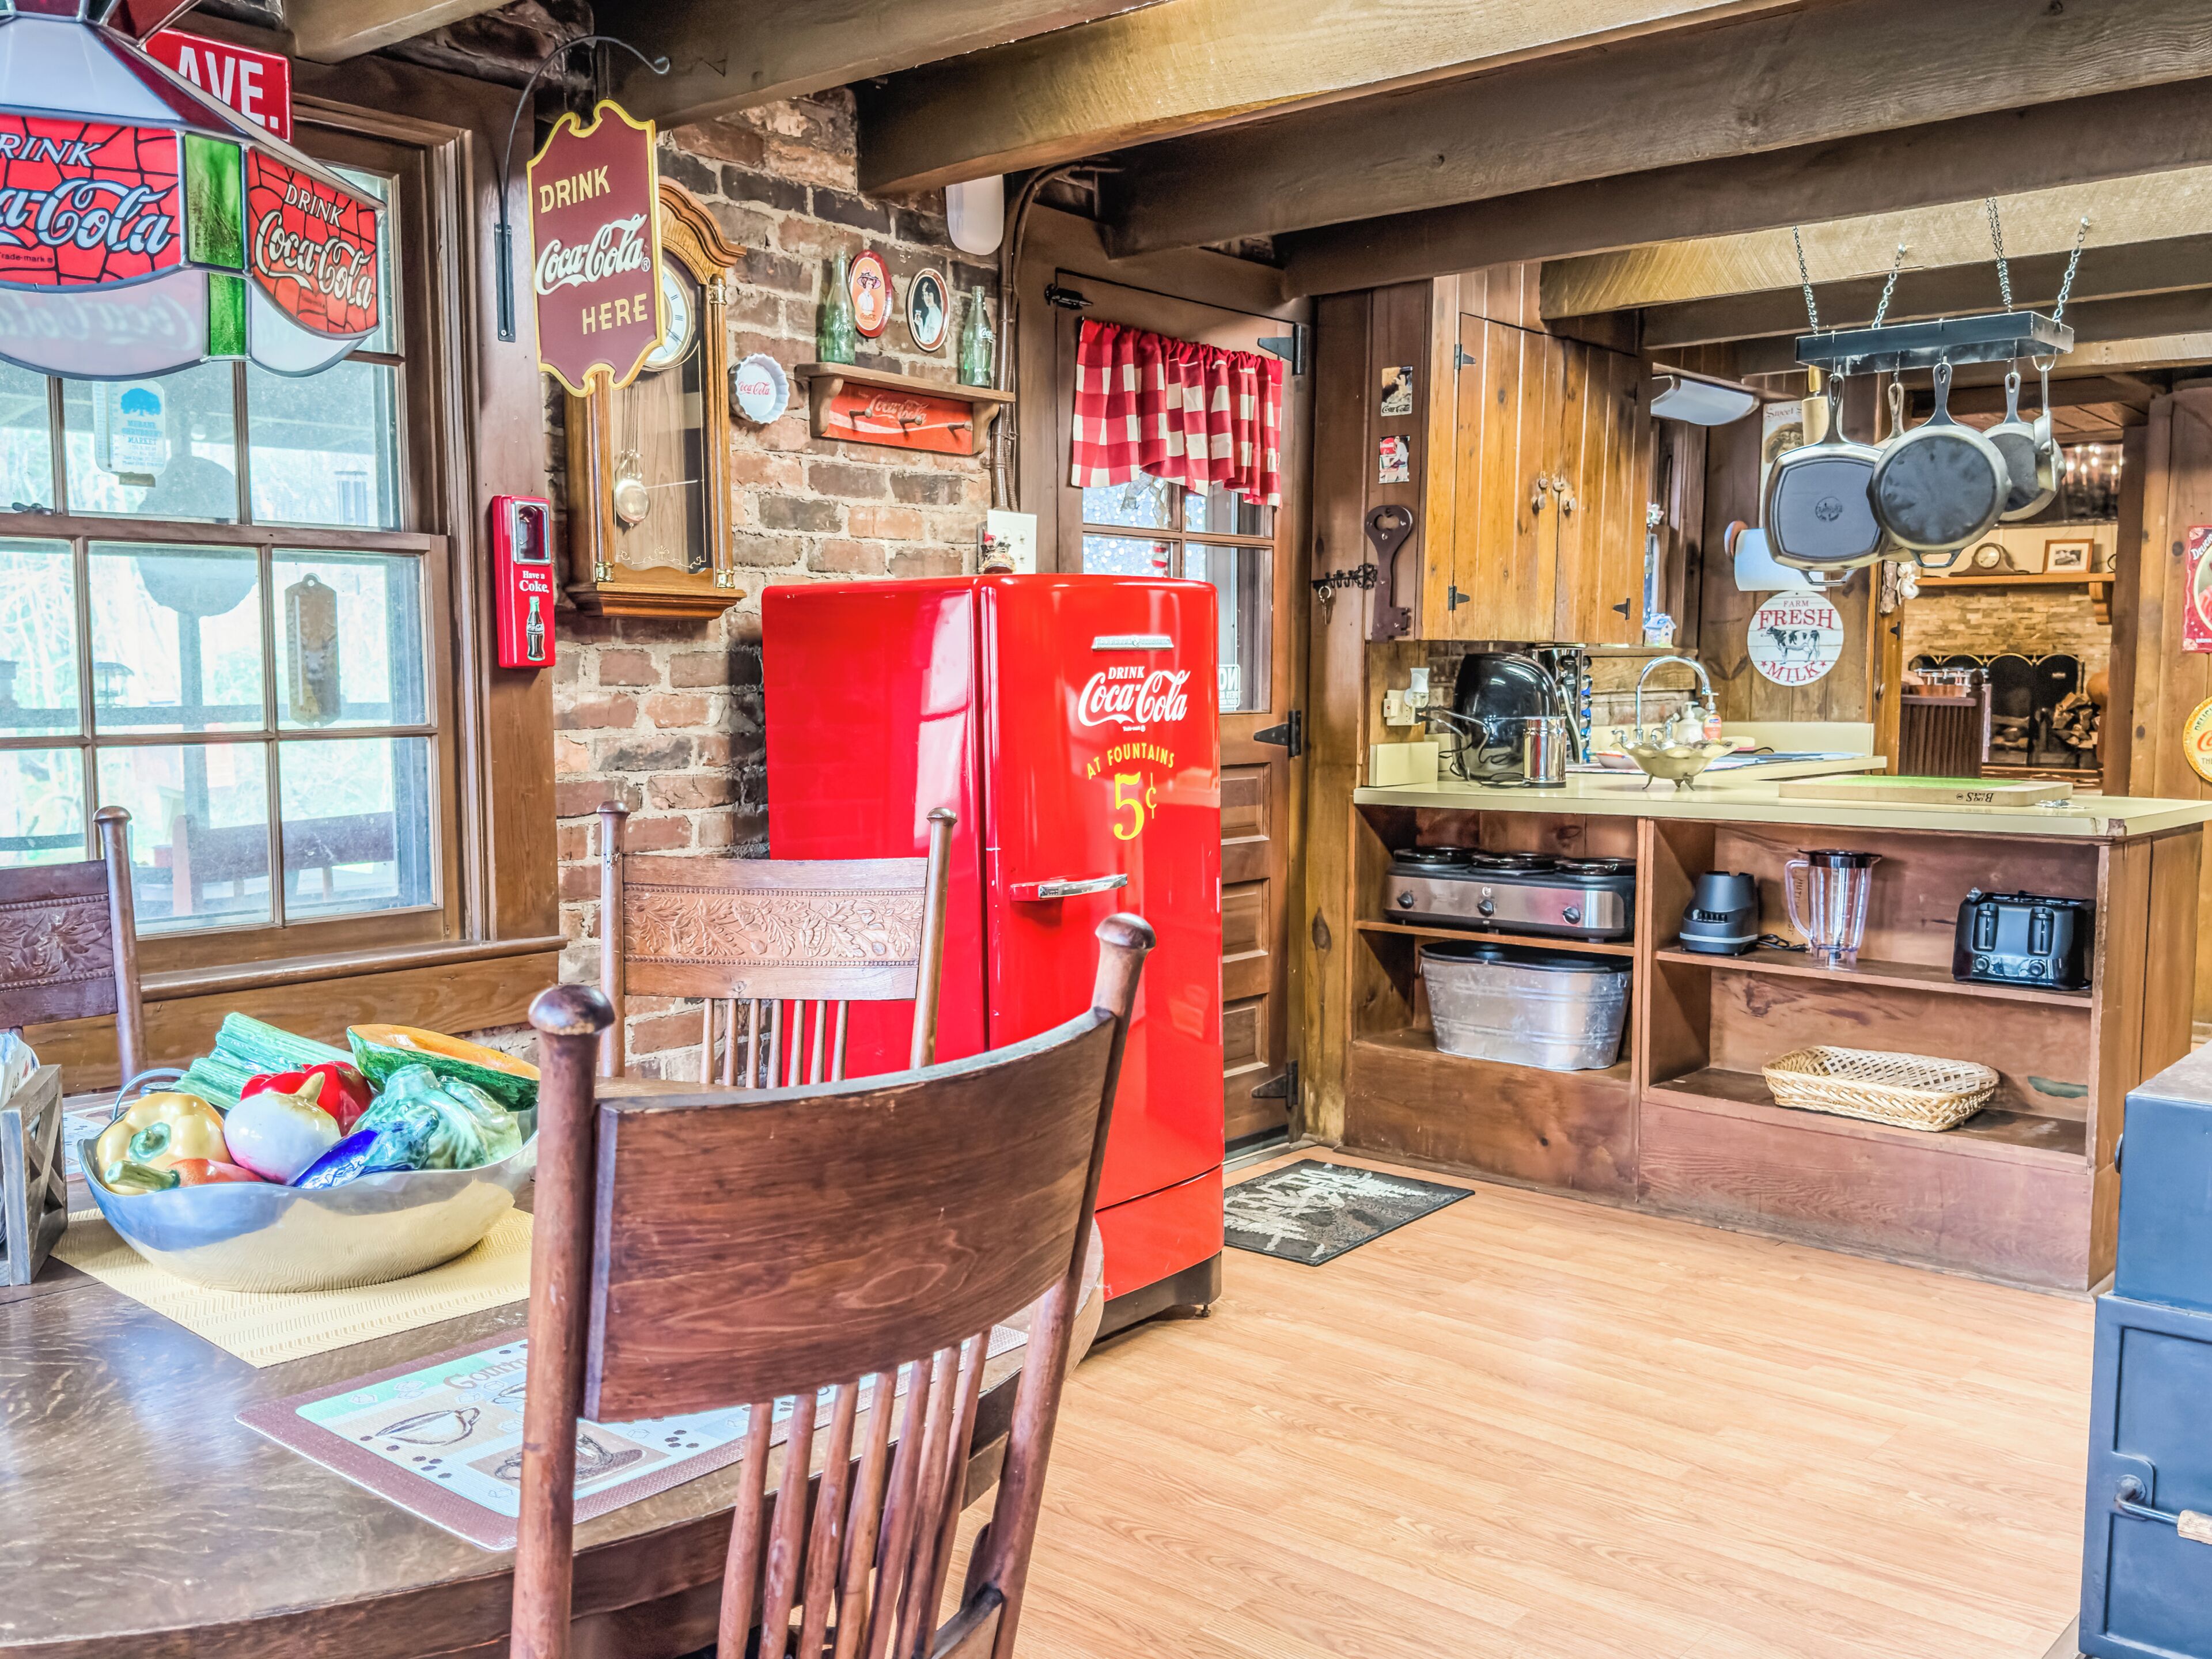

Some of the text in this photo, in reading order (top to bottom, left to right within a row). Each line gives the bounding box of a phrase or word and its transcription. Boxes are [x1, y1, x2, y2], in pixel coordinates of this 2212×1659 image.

[179, 46, 278, 129] AVE.
[0, 133, 101, 166] RINK
[284, 183, 344, 228] DRINK
[540, 165, 611, 213] DRINK
[0, 178, 172, 255] a-Cola
[0, 252, 44, 262] rade-mark
[256, 210, 374, 309] Coca-Cola
[535, 213, 647, 295] Coca-Cola
[582, 293, 648, 335] HERE
[738, 381, 770, 395] Coca-Cola
[519, 580, 548, 592] Coke
[522, 570, 539, 579] Have
[1757, 609, 1834, 630] FRESH
[1108, 666, 1145, 679] DRINK
[1766, 660, 1820, 683] MILK
[1078, 670, 1191, 726] Coca-Cola
[1087, 743, 1175, 780] AT FOUNTAINS
